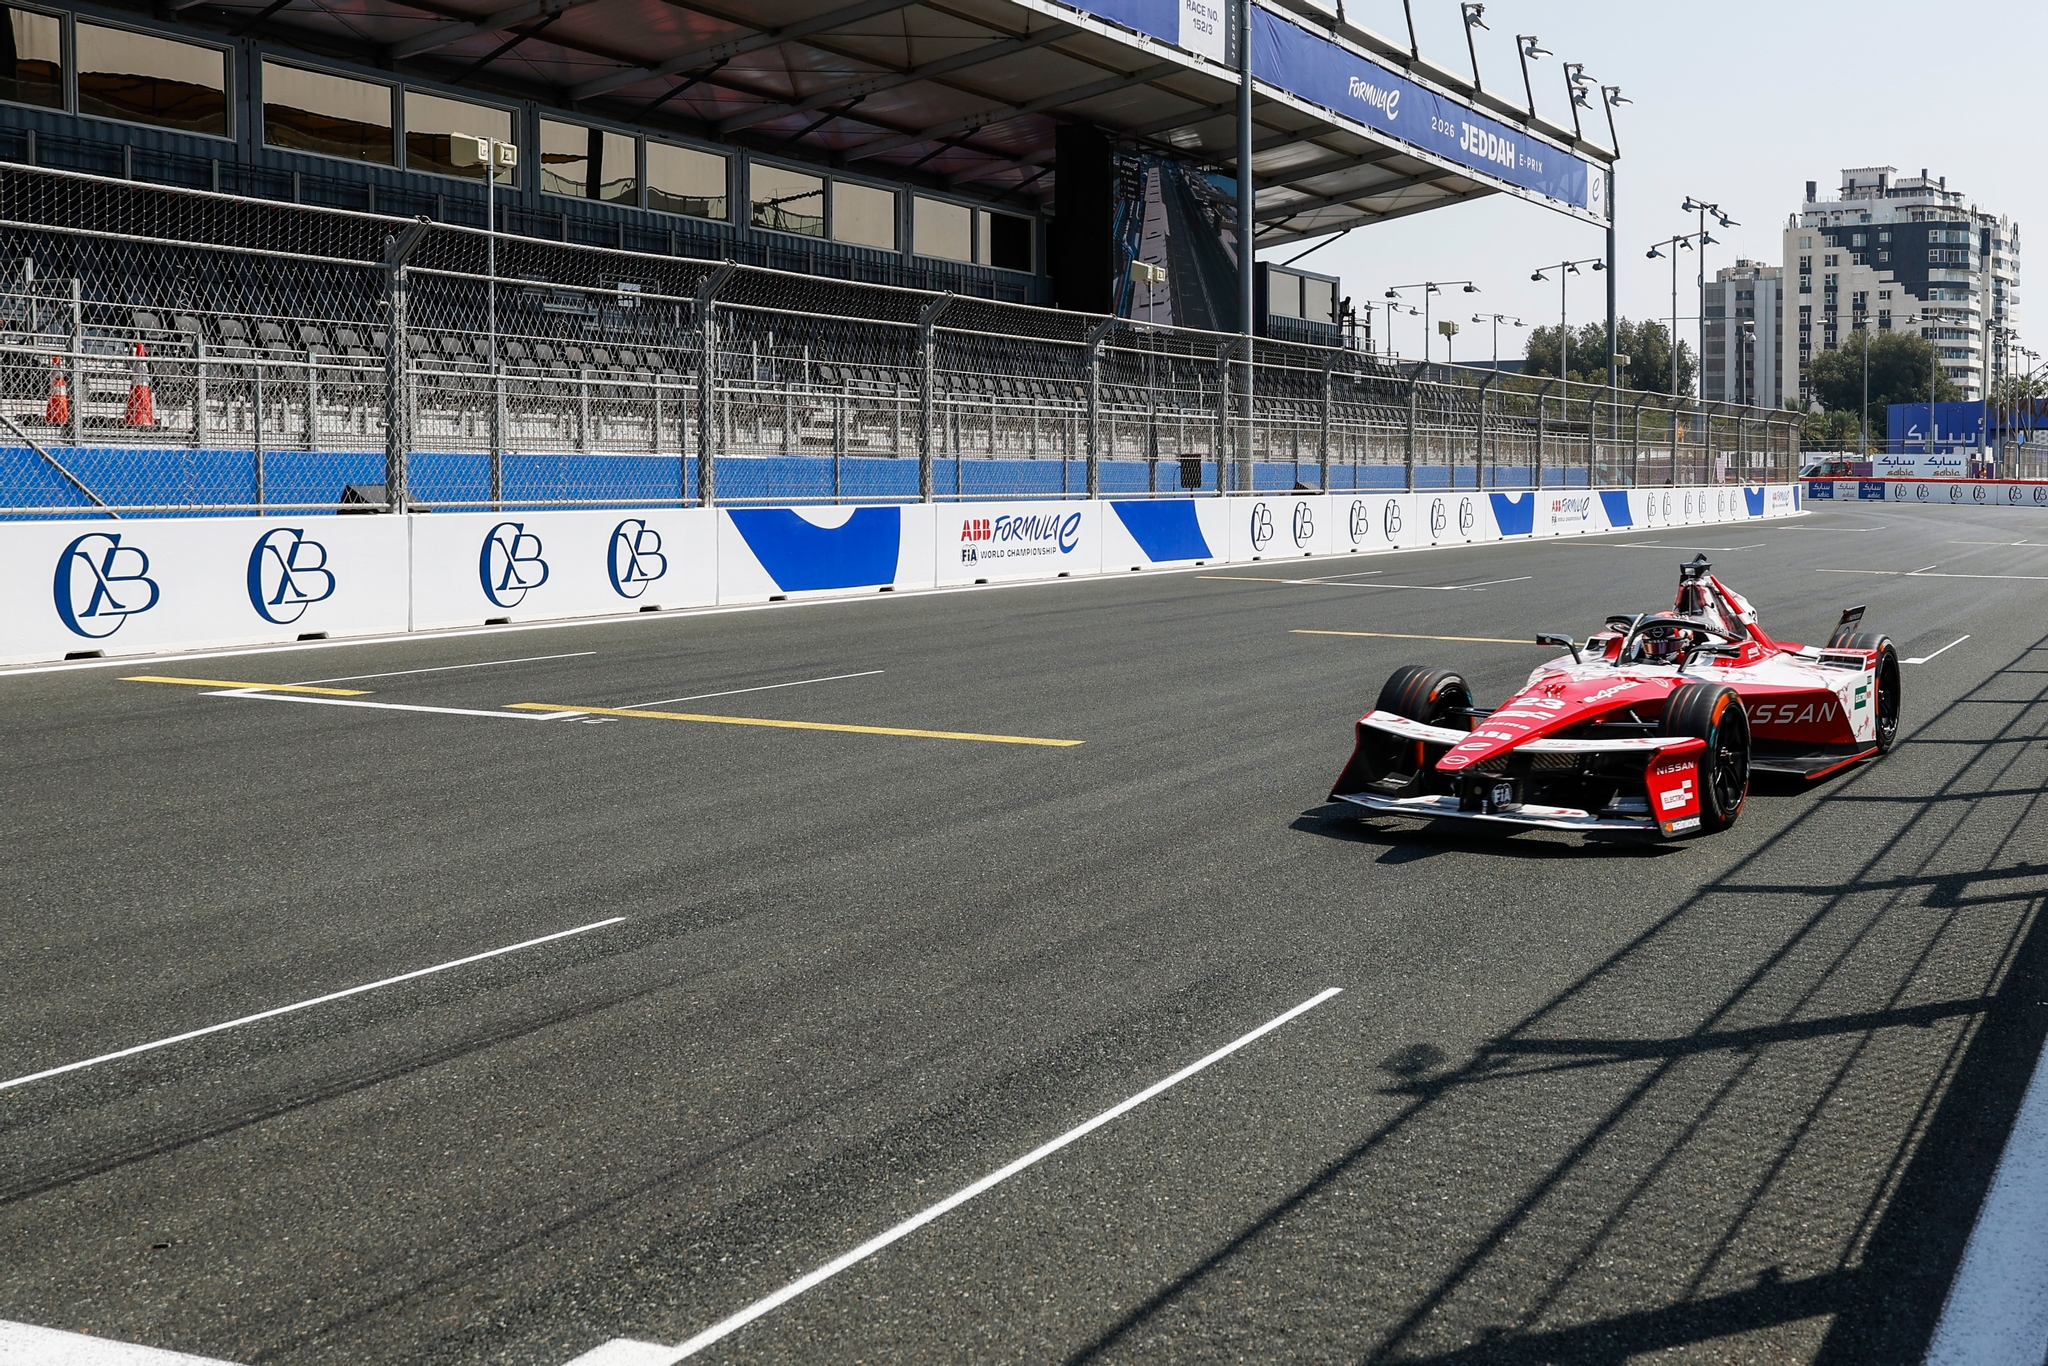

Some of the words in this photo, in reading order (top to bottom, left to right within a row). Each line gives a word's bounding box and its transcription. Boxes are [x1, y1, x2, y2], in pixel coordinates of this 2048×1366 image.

[1186, 0, 1206, 17] RACE
[1207, 8, 1219, 22] NO.
[1193, 18, 1213, 35] 152/3
[1431, 116, 1455, 138] 2026
[1460, 121, 1515, 169] JEDDAH
[1519, 153, 1543, 174] E-PRIX
[1904, 424, 1976, 450] ساك
[961, 518, 991, 541] ABB
[992, 514, 1060, 543] FORMULA
[980, 549, 1005, 559] WORLD
[1007, 547, 1057, 557] CHAMPIONSHIP
[1509, 697, 1566, 710] 23
[1747, 701, 1838, 724] ISSAN
[1467, 730, 1513, 741] ABB
[1656, 761, 1694, 776] NISSAN
